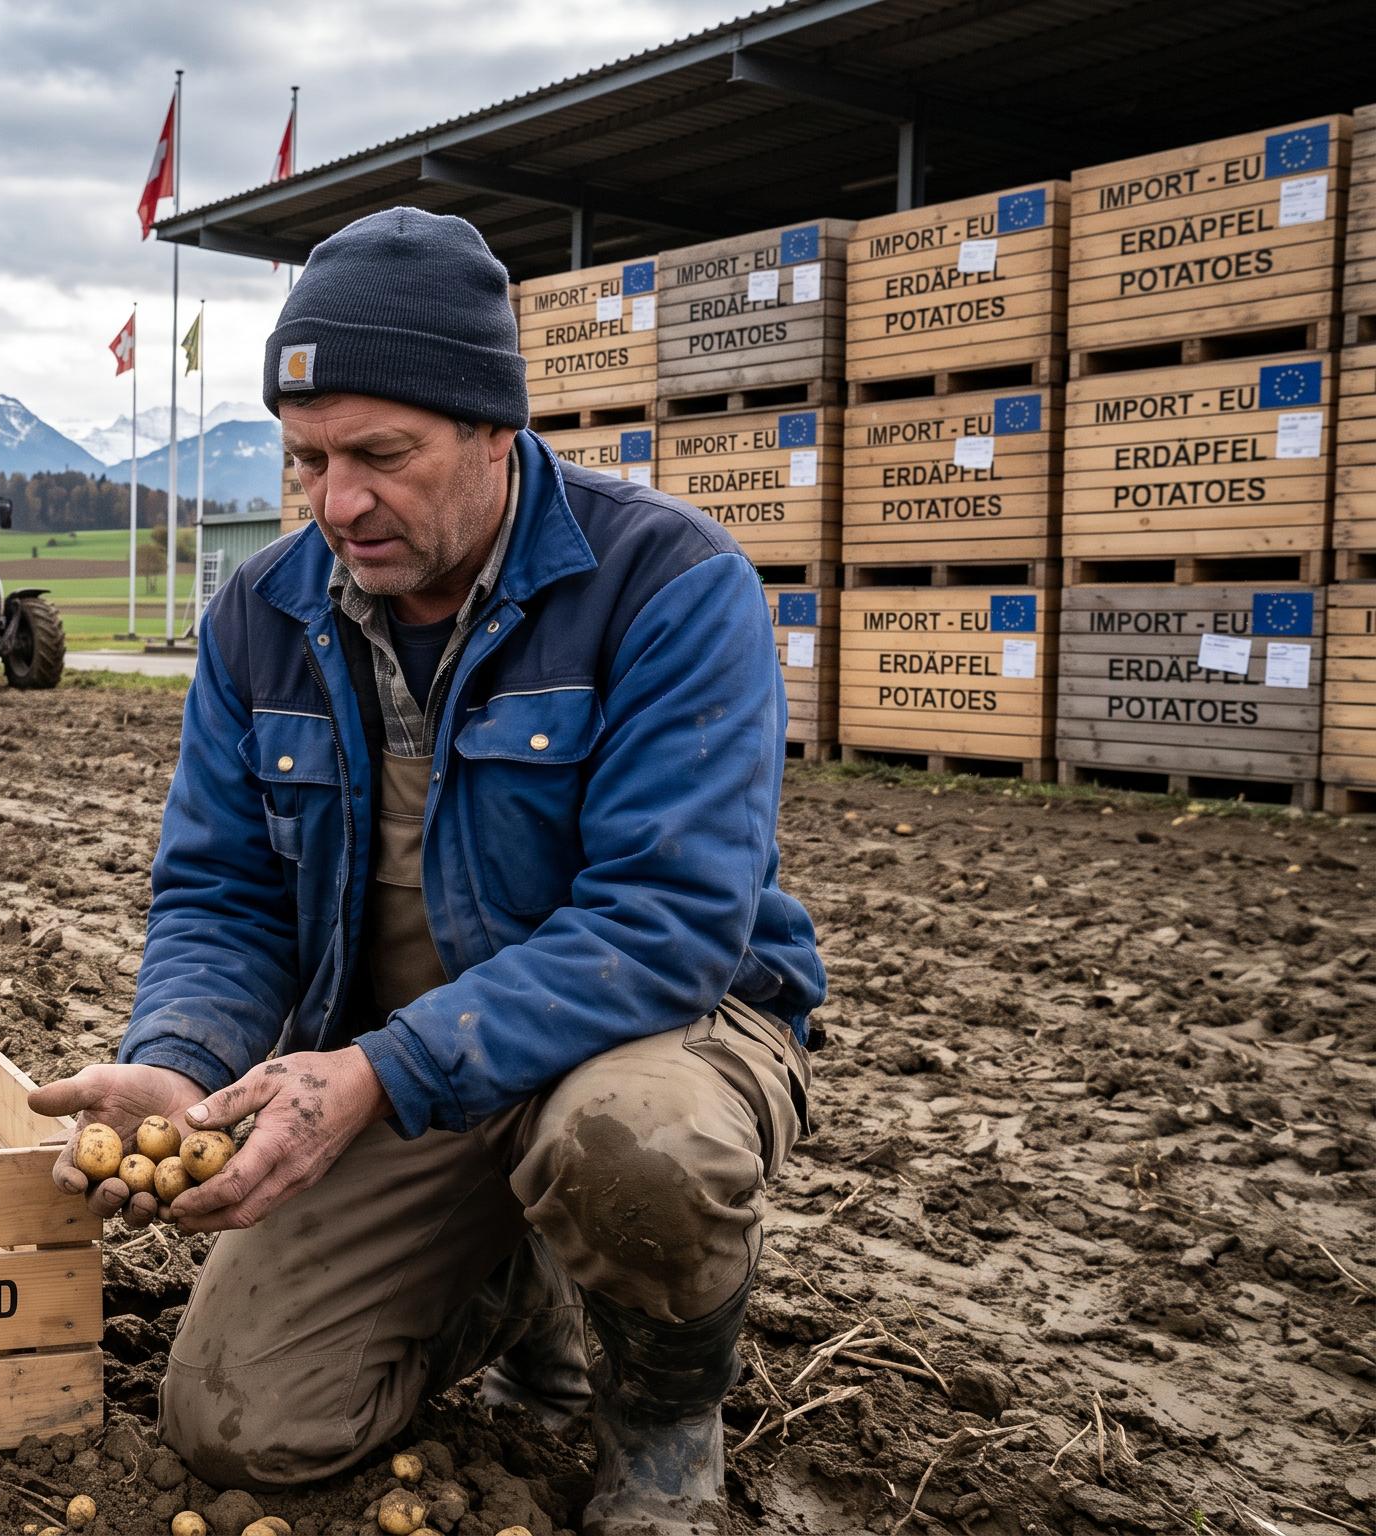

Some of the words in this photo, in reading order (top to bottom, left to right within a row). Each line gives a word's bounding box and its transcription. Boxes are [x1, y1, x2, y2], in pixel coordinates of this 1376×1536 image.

[1099, 168, 1200, 210] IMPORT
[1224, 155, 1261, 185] EU
[870, 225, 948, 259] IMPORT
[966, 214, 995, 239] EU
[1120, 208, 1273, 256] ERDÄPFEL
[677, 256, 739, 285] IMPORT
[754, 249, 777, 270] EU
[1120, 249, 1273, 296] POTATOES
[534, 287, 588, 311] IMPORT
[600, 280, 620, 298] EU
[885, 296, 1005, 334] POTATOES
[689, 321, 787, 354] POTATOES
[545, 347, 629, 375] POTATOES
[1095, 393, 1194, 423] IMPORT
[1219, 386, 1255, 412] EU
[676, 434, 738, 456] IMPORT
[753, 430, 776, 449] EU
[867, 420, 944, 446] IMPORT
[964, 415, 992, 437] EU
[599, 445, 619, 464] EU
[1114, 438, 1267, 471] ERDÄPFEL
[688, 468, 785, 494] ERDÄPFEL
[1114, 477, 1266, 509] POTATOES
[701, 502, 785, 524] TATOES
[882, 494, 1002, 521] POTATOES
[863, 612, 941, 631] IMPORT
[960, 612, 989, 631] EU
[1090, 611, 1188, 633] IMPORT
[1213, 612, 1249, 634] EU
[879, 650, 998, 676] ERDÄPFEL
[879, 686, 997, 711] POTATOES
[1107, 696, 1259, 725] POTATOES
